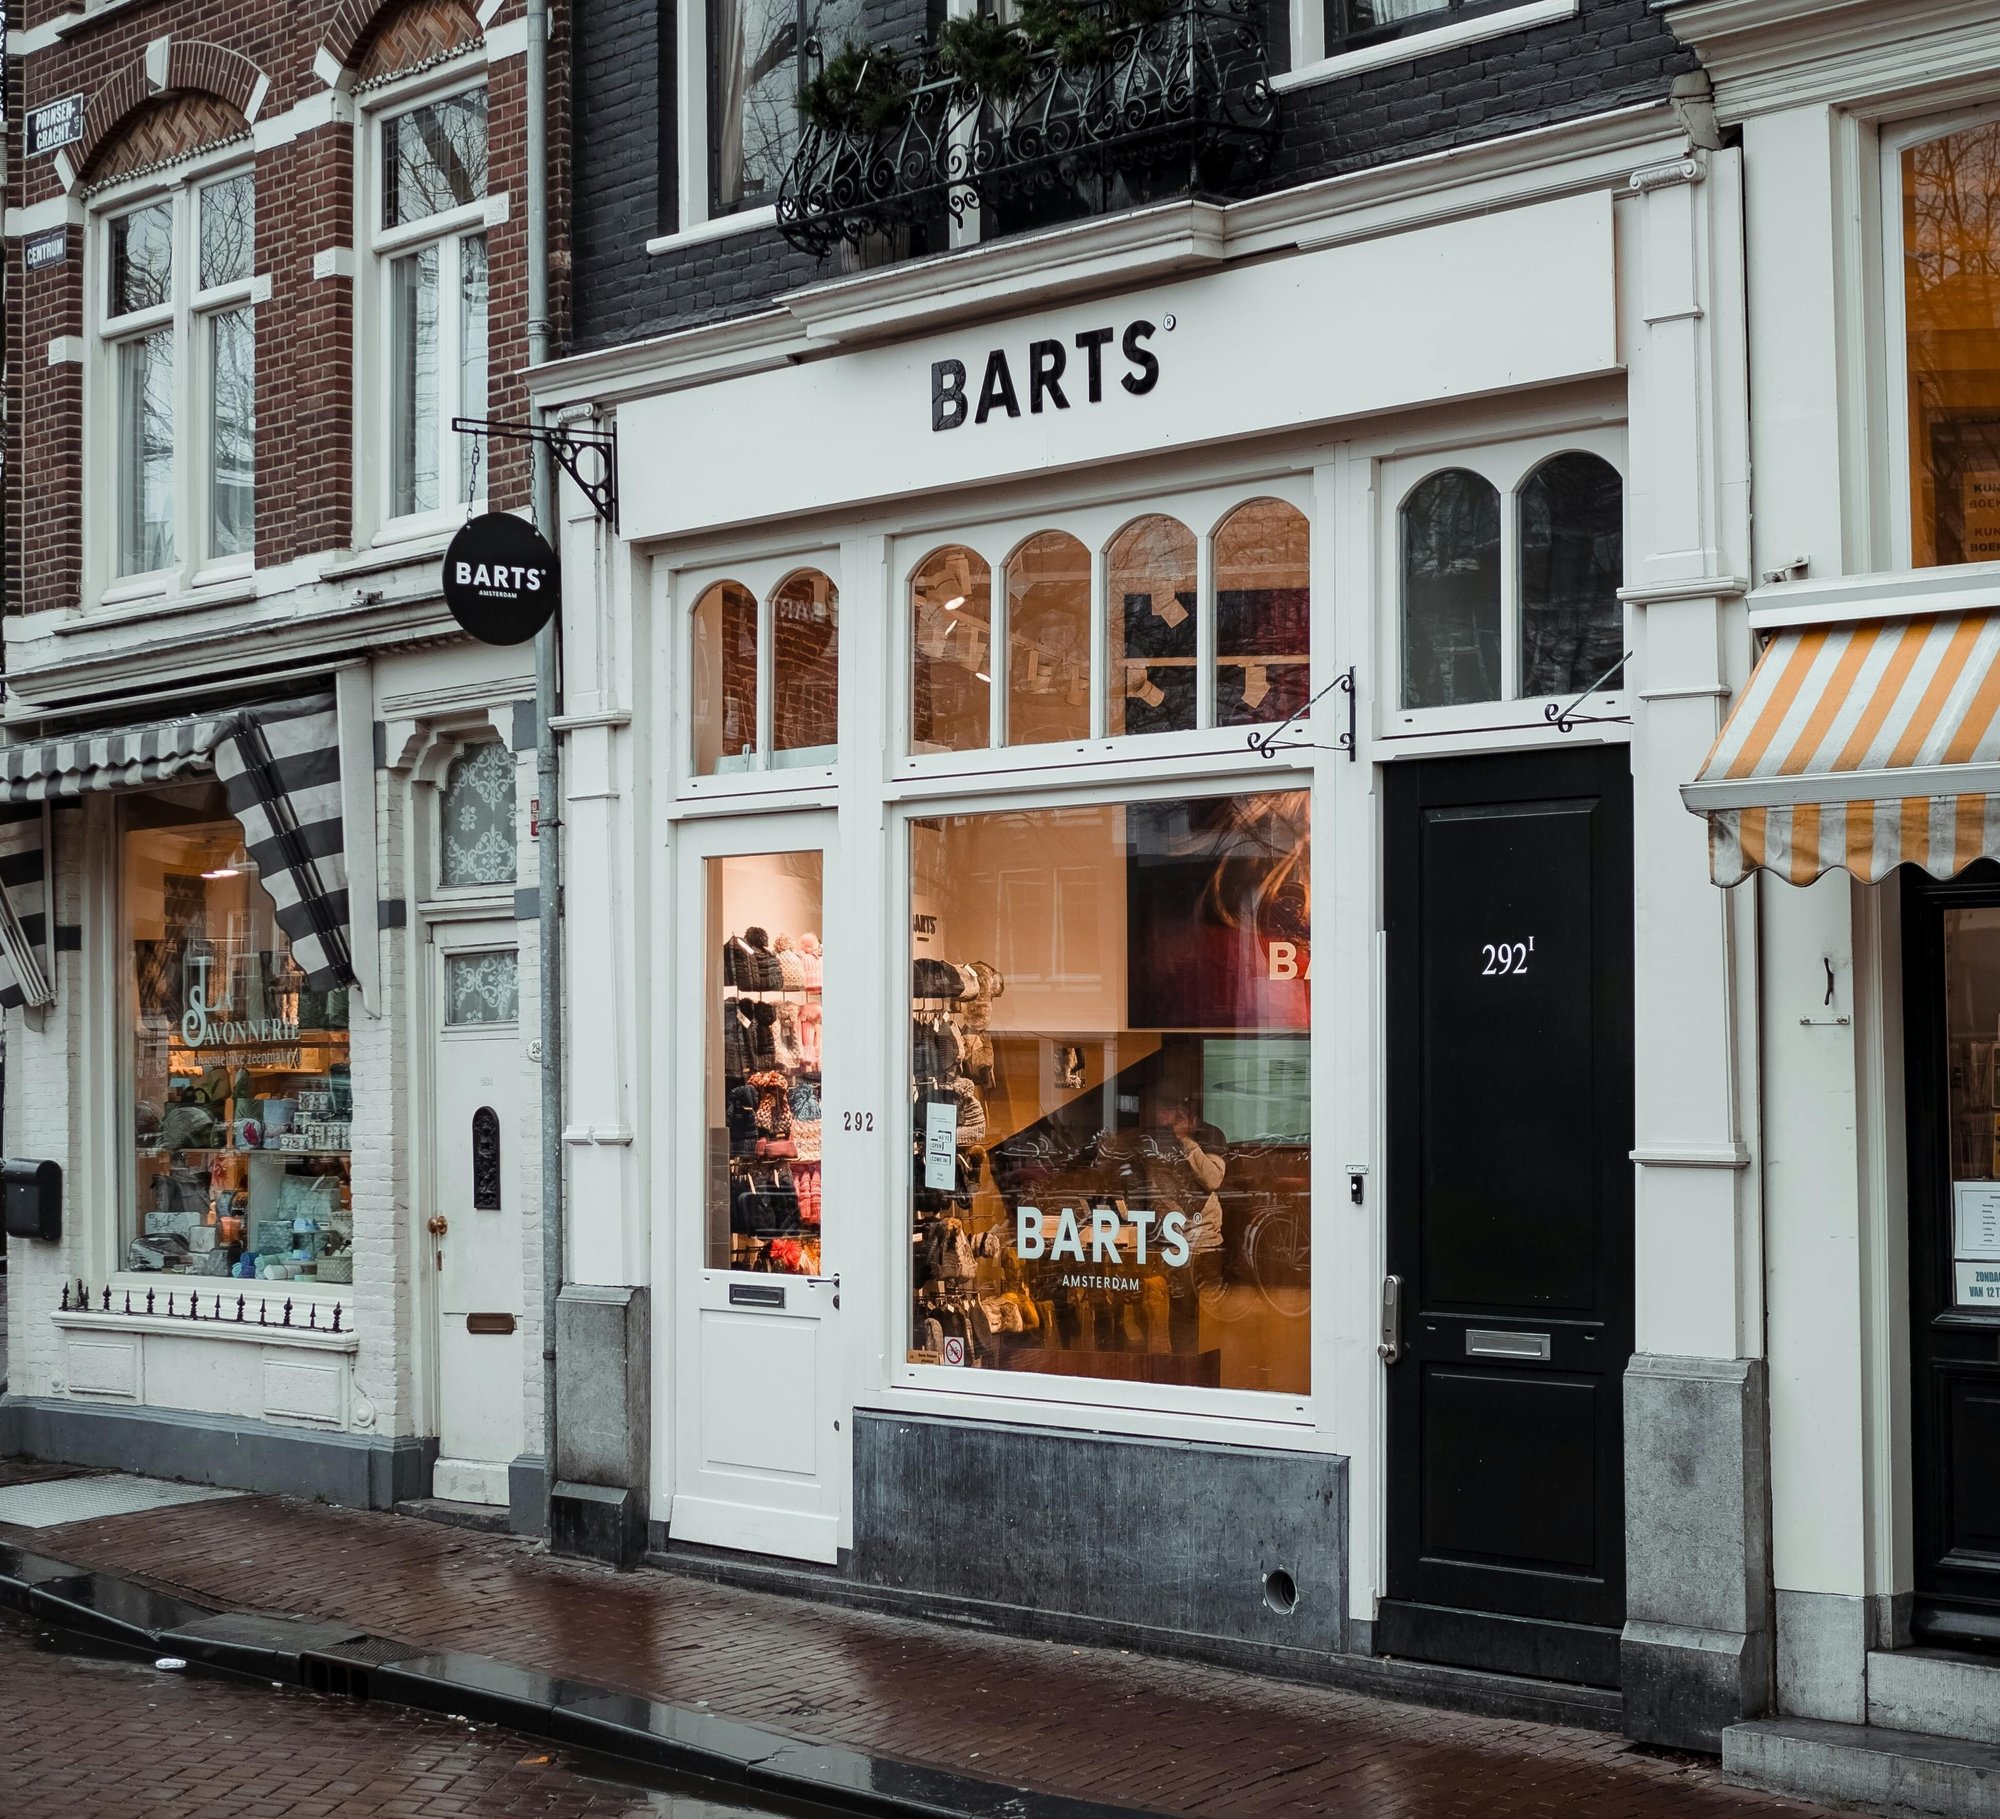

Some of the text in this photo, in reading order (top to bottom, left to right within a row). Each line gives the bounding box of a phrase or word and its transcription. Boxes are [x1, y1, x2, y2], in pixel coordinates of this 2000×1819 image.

[35, 100, 76, 131] PRINSEN-
[27, 237, 64, 264] CENTRUM
[478, 590, 518, 599] AMSTERDAM
[844, 1111, 873, 1132] 292
[1062, 1274, 1139, 1291] AMSTERDAM
[1969, 1286, 1983, 1297] VAN
[1986, 1286, 1994, 1297] 12
